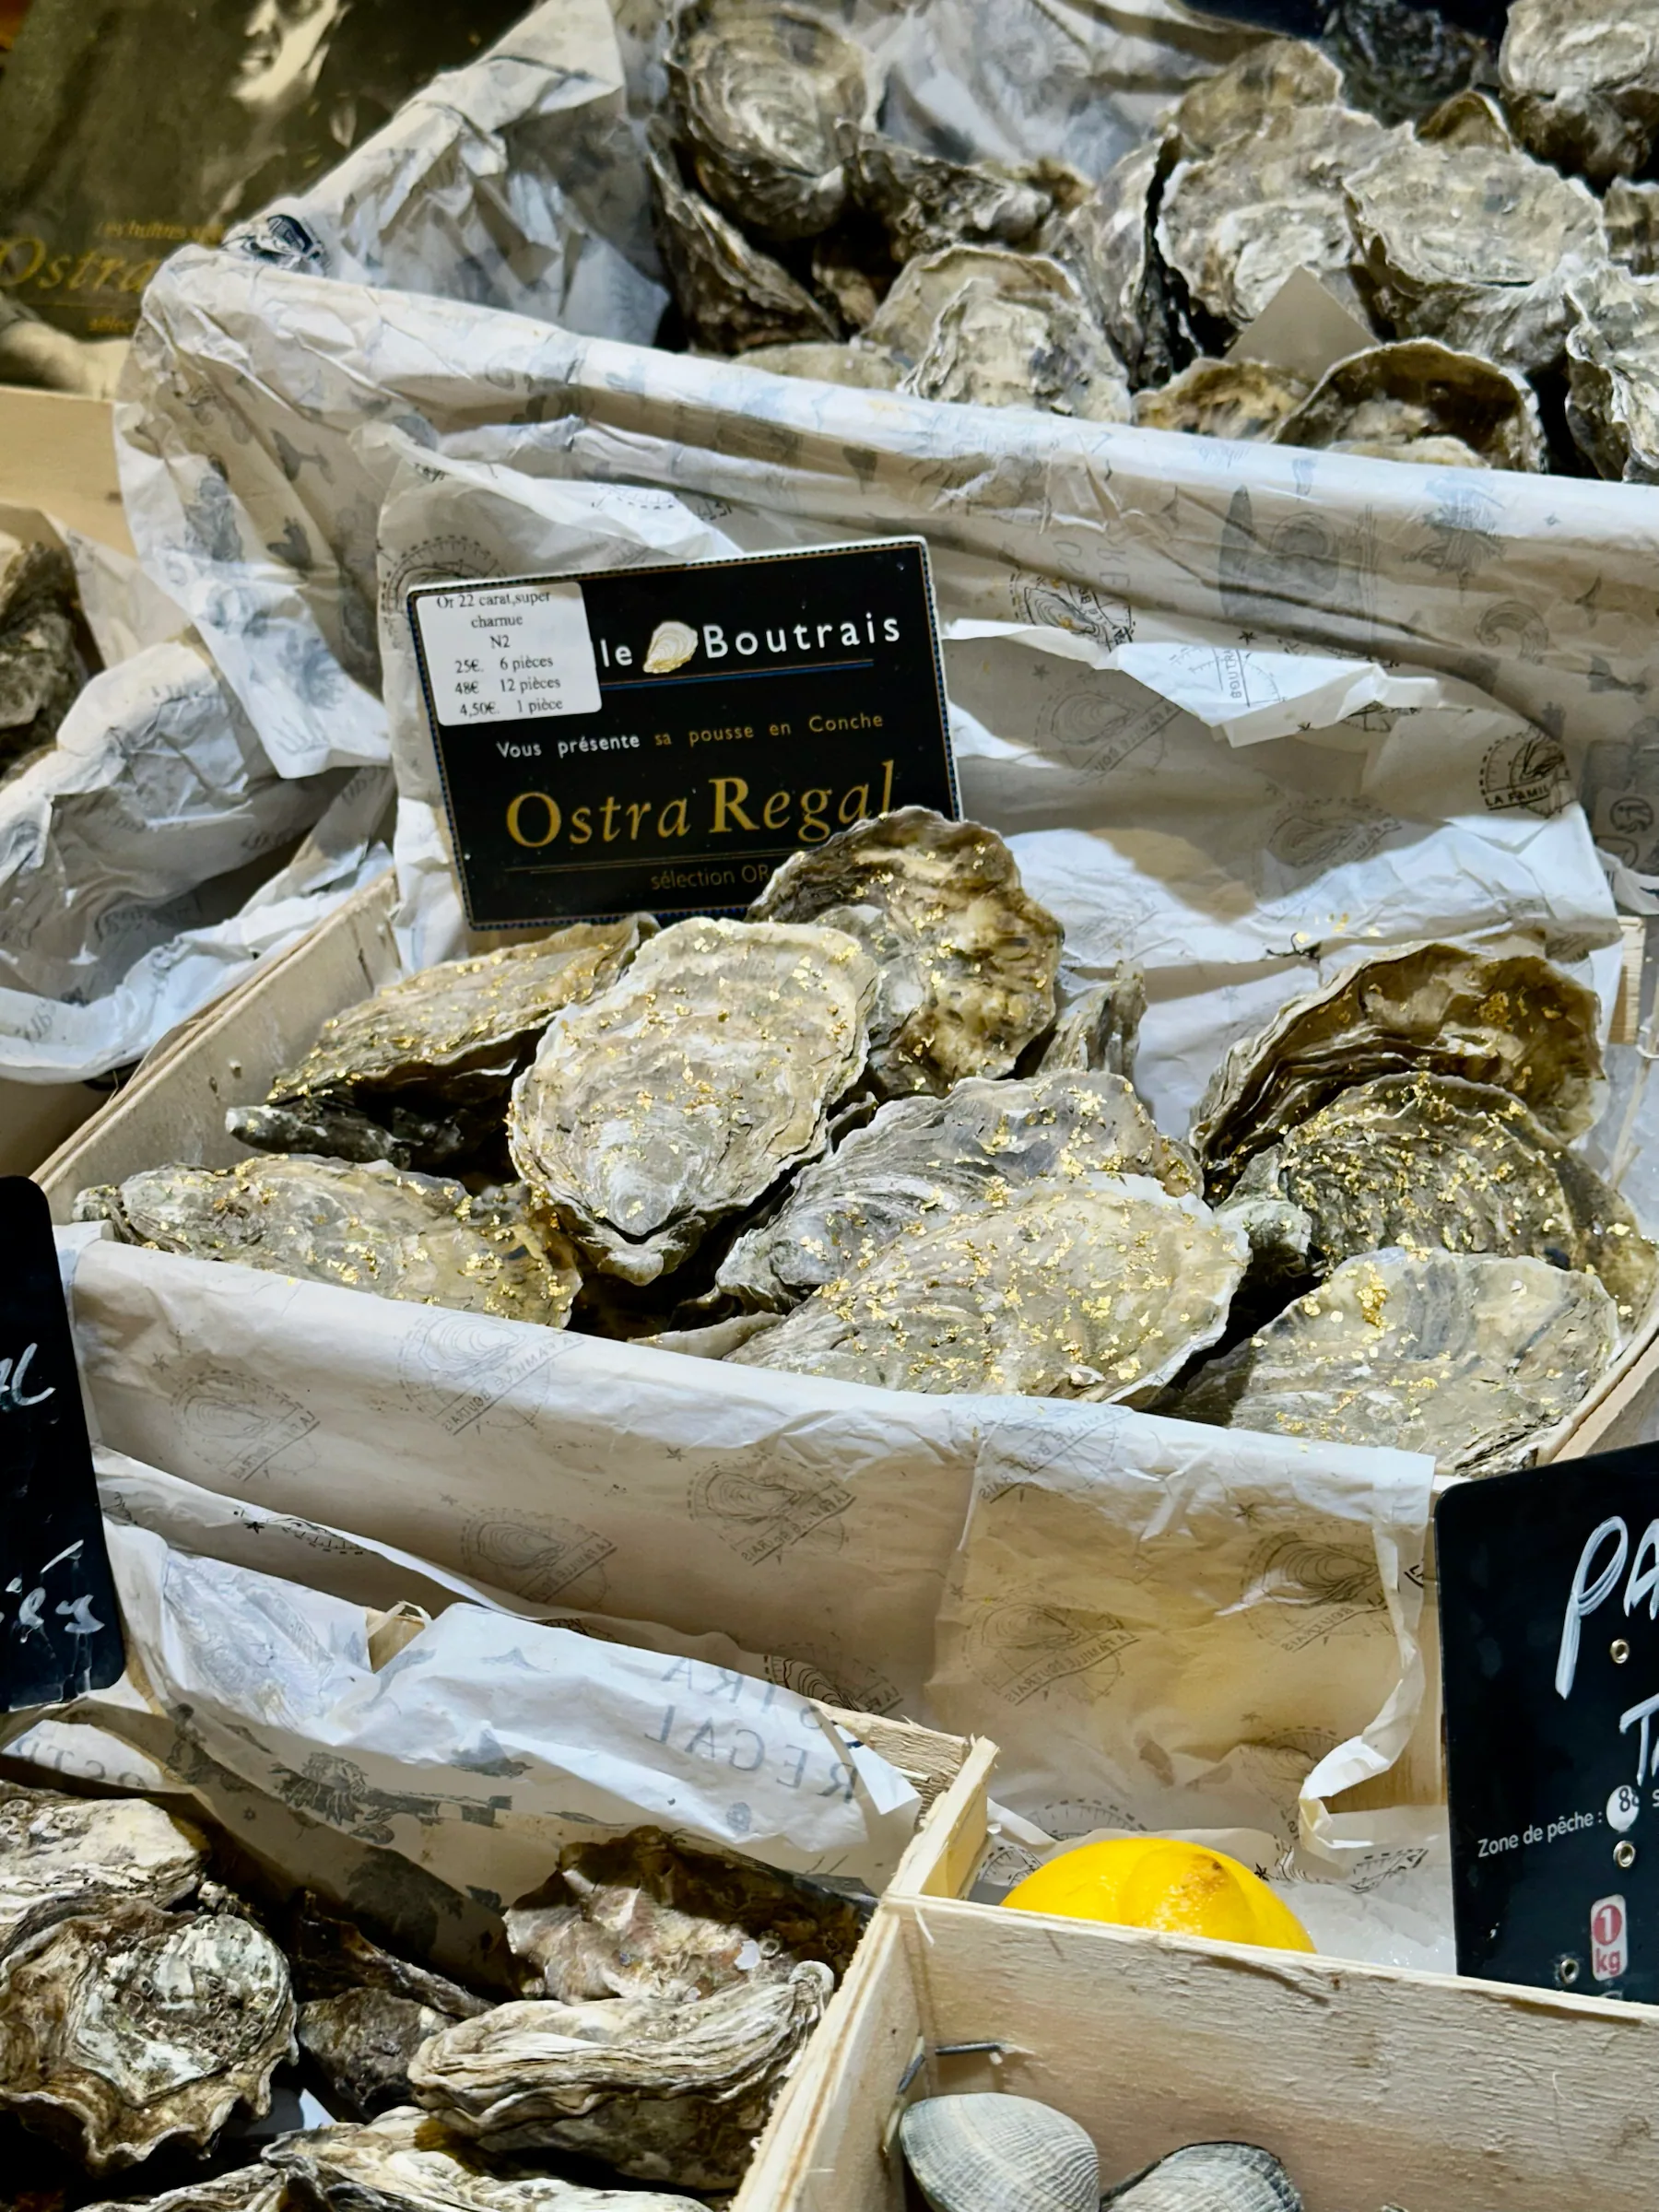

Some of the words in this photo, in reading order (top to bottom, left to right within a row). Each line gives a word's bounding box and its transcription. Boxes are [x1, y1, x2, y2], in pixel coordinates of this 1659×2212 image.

[459, 594, 476, 607] 22
[489, 635, 511, 649] N2
[702, 611, 901, 659] Boutrais
[500, 657, 509, 671] 6
[512, 655, 554, 673] pièces
[454, 681, 480, 695] 48€
[500, 678, 516, 692] 12
[520, 677, 561, 694] pièces
[516, 700, 524, 713] 1
[527, 698, 564, 715] pièce
[495, 740, 542, 759] Vous
[557, 734, 641, 759] présente
[654, 733, 672, 747] sa
[688, 725, 754, 747] pousse
[769, 723, 792, 736] en
[808, 712, 884, 733] Conche
[506, 791, 691, 848] Ostra
[708, 759, 894, 842] Regal
[650, 868, 735, 890] sélection
[741, 864, 771, 885] OR
[1477, 1834, 1519, 1858] Zone
[1523, 1825, 1544, 1845] de
[1547, 1811, 1594, 1843] pêche
[1599, 1908, 1613, 1943] 1
[1595, 1947, 1621, 1977] kg
